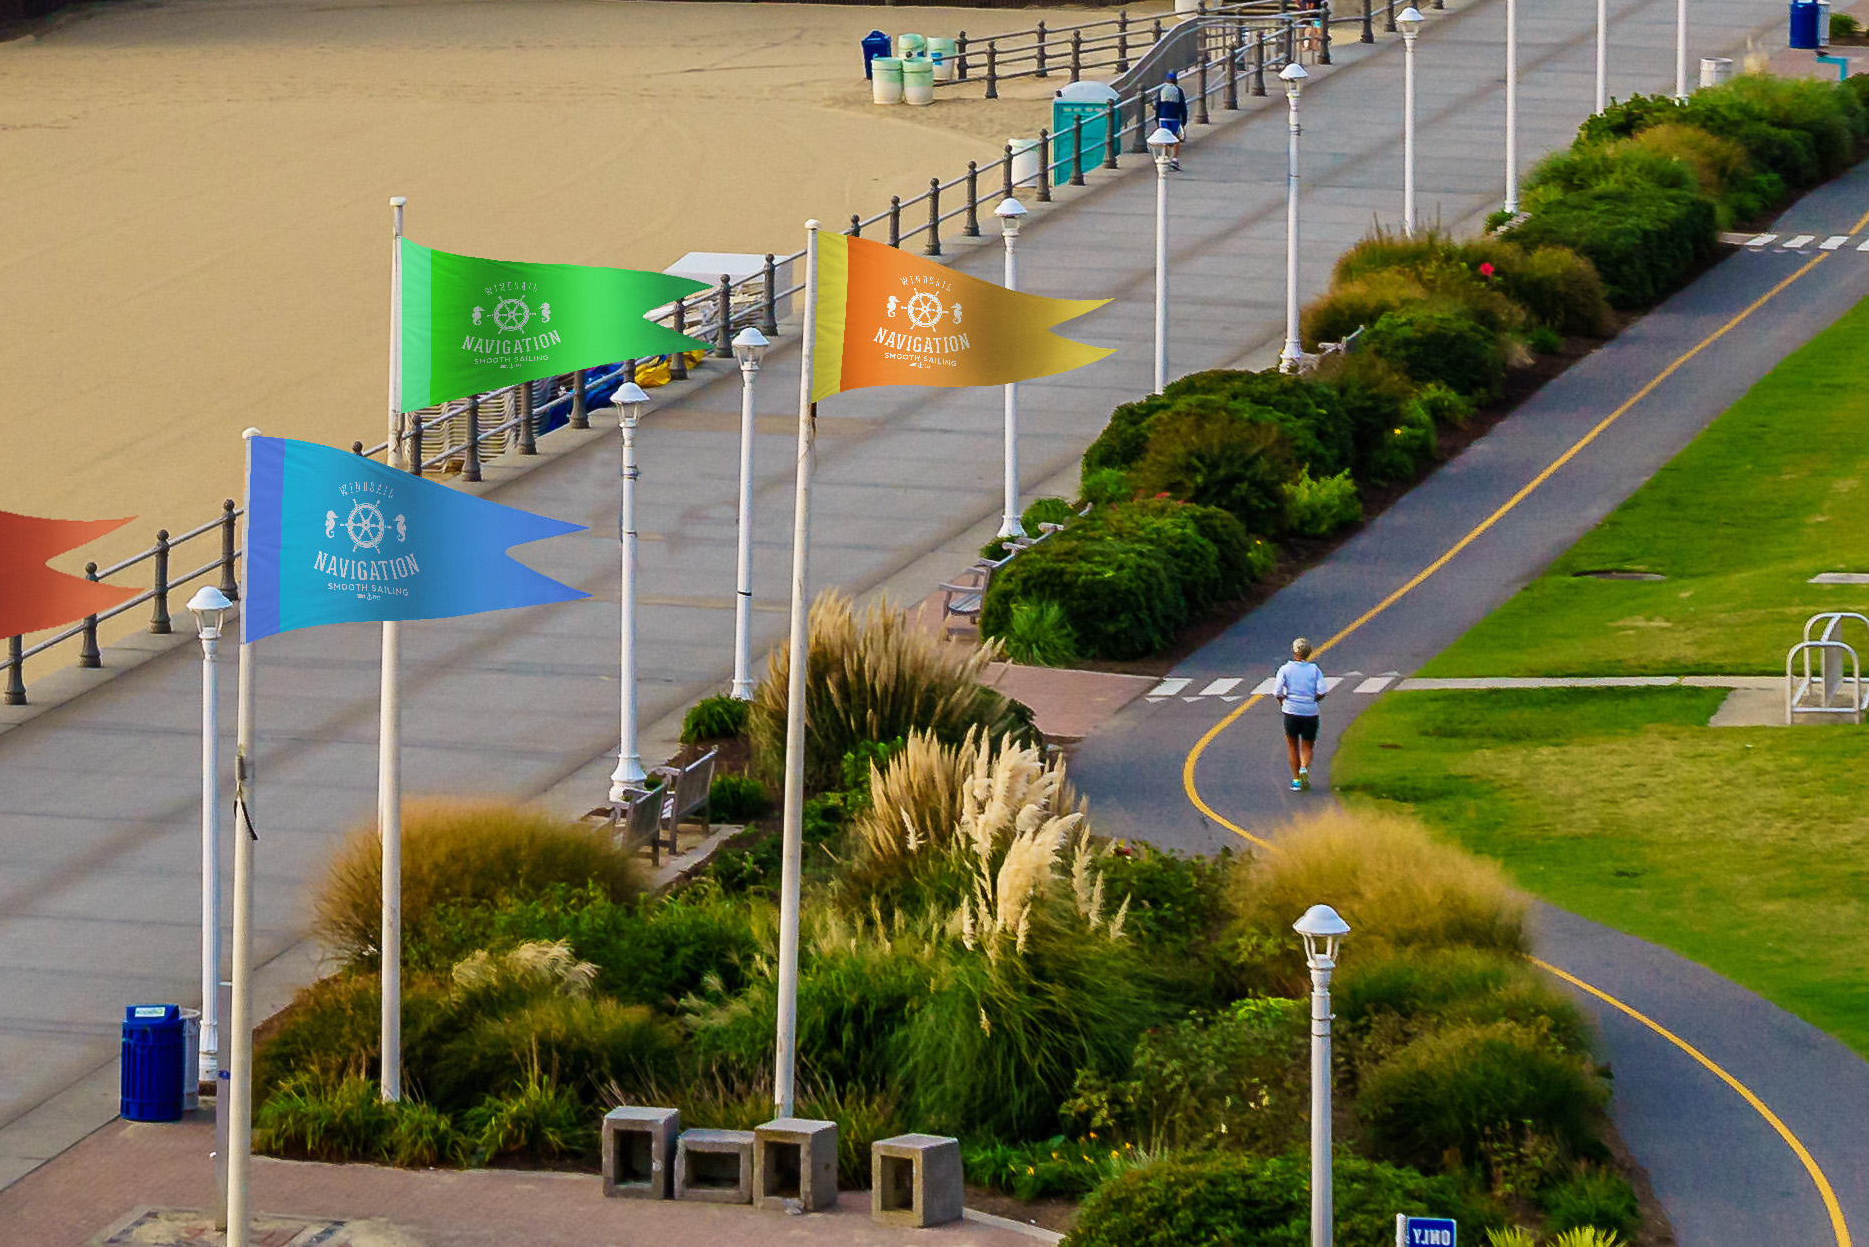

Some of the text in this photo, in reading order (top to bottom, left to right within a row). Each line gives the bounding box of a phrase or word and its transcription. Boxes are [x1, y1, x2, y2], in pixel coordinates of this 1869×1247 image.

[461, 329, 562, 354] NAVIGATION
[872, 327, 971, 354] NAVIGATION
[474, 354, 549, 365] SMOOTH SAILING
[884, 352, 921, 361] SMOOTH
[923, 355, 957, 367] SAILING
[313, 550, 420, 581] NAVIGATION
[327, 582, 368, 592] SMOOTH
[371, 584, 409, 597] SAILING
